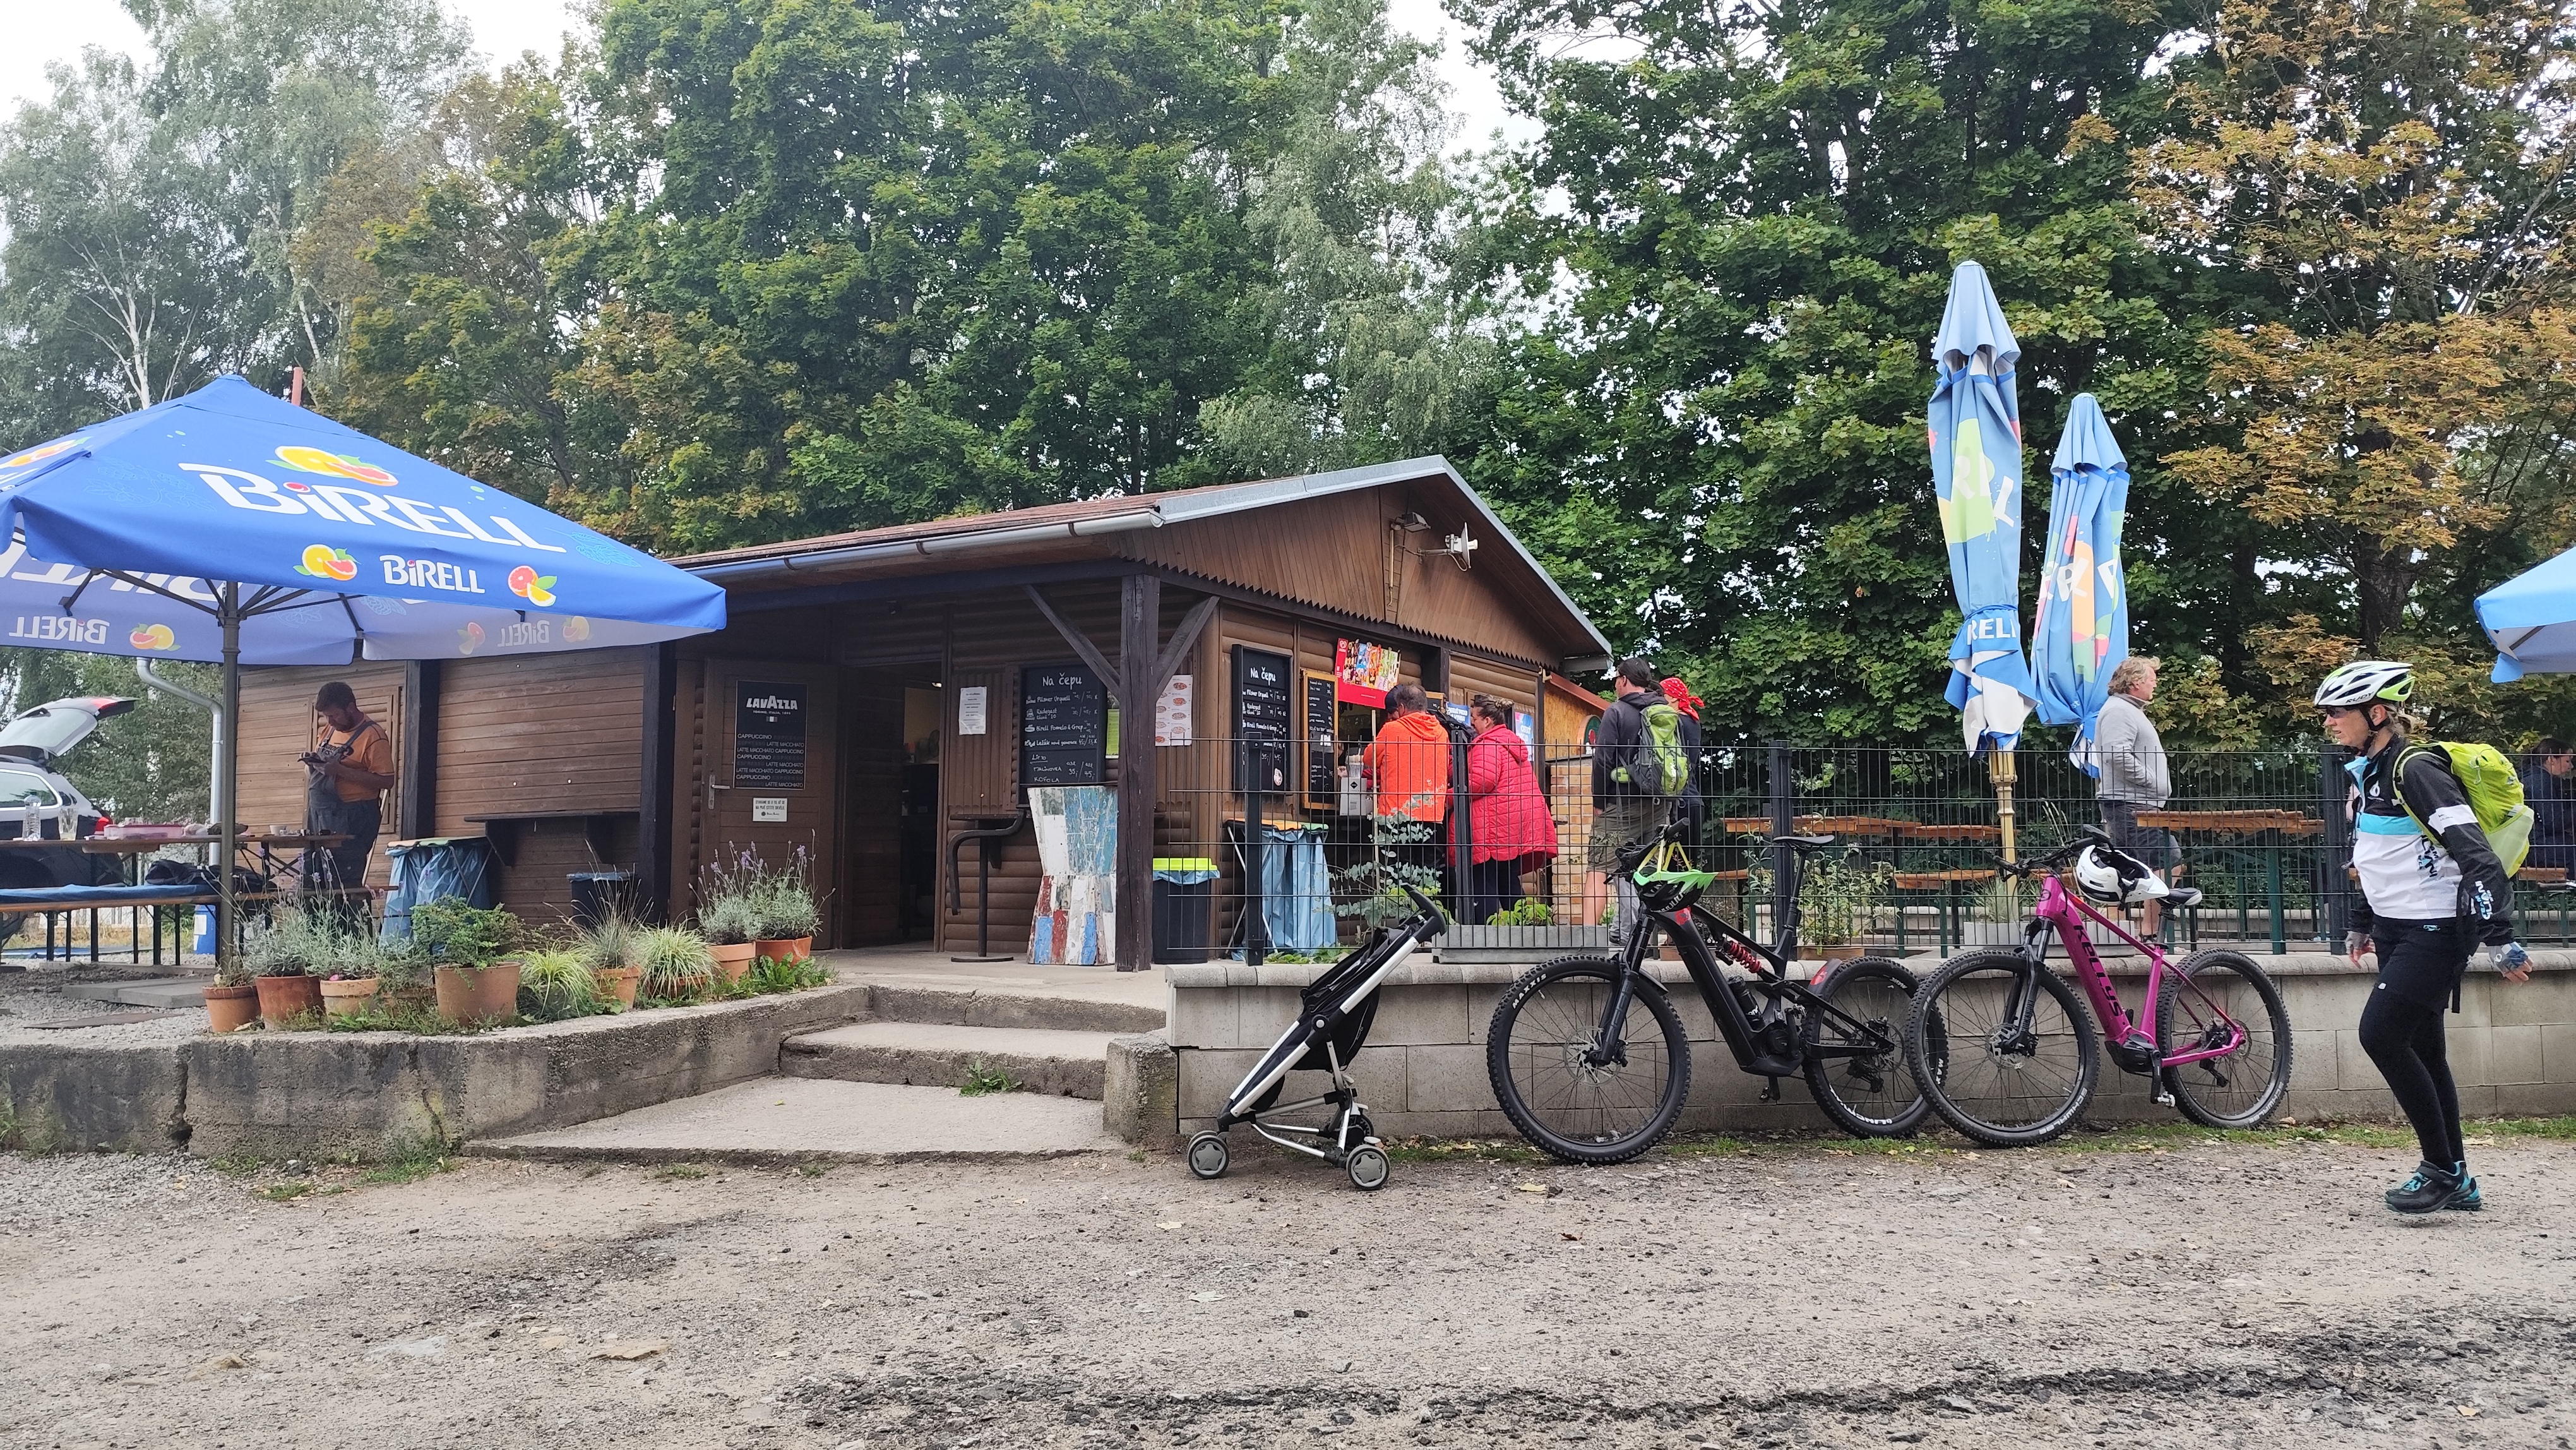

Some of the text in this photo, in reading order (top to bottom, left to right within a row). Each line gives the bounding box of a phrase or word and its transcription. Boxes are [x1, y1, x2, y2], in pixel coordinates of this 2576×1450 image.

[1042, 673, 1082, 690] Na čepu
[1250, 666, 1276, 686] Na čepu
[746, 695, 797, 710] LAVAZZA
[1054, 695, 1071, 704] Urquell
[2346, 692, 2374, 704] RUDY
[1512, 973, 1547, 1009] MAXXIS
[2039, 1087, 2088, 1135] SCHWALBE
[2248, 1081, 2284, 1123] SCHWALBE
